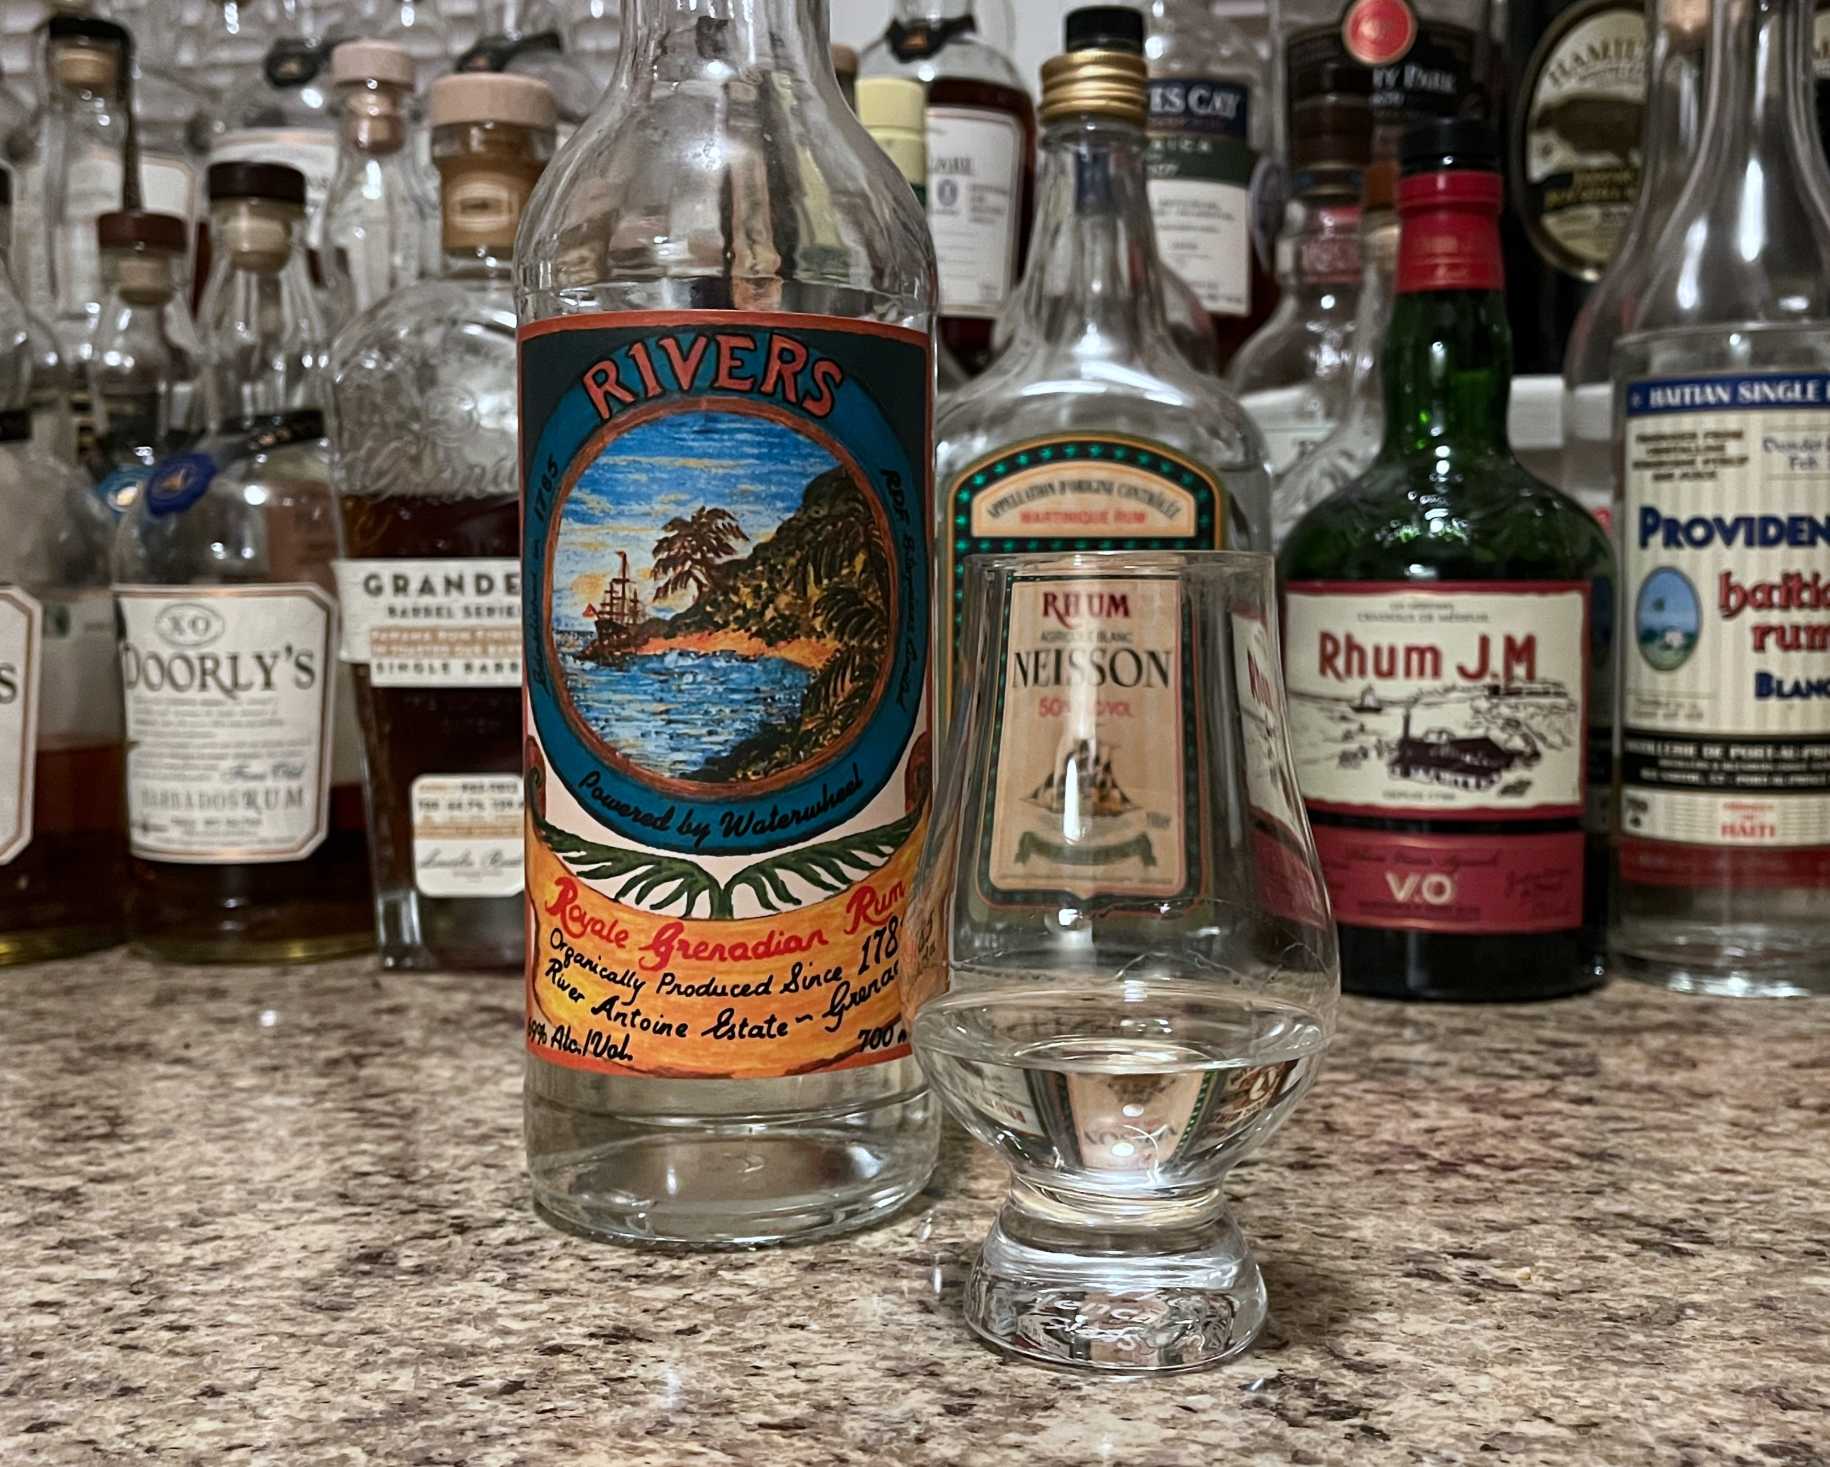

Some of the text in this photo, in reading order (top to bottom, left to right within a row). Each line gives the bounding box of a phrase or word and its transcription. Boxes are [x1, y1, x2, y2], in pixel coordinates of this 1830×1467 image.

[580, 332, 844, 421] RIVERS
[1650, 384, 1731, 407] HAITIAN
[1737, 379, 1821, 404] SINGLE
[1041, 590, 1131, 630] RHUM
[119, 642, 317, 700] DOORLY'S
[1012, 647, 1173, 690] NEISSON
[1318, 630, 1443, 683] Rhum
[241, 786, 305, 816] RUM
[577, 770, 675, 832] Powered
[676, 809, 711, 849] by
[719, 762, 864, 838] Waterwheel
[544, 876, 630, 950] Royale
[638, 921, 830, 973] Grenadian
[549, 914, 904, 1007] Organically Produced Since 178
[544, 957, 587, 1003] River
[590, 994, 689, 1039] Antoine
[700, 1007, 789, 1041] Estate
[550, 1023, 634, 1062] Alc./Vol.
[857, 1025, 894, 1053] 700
